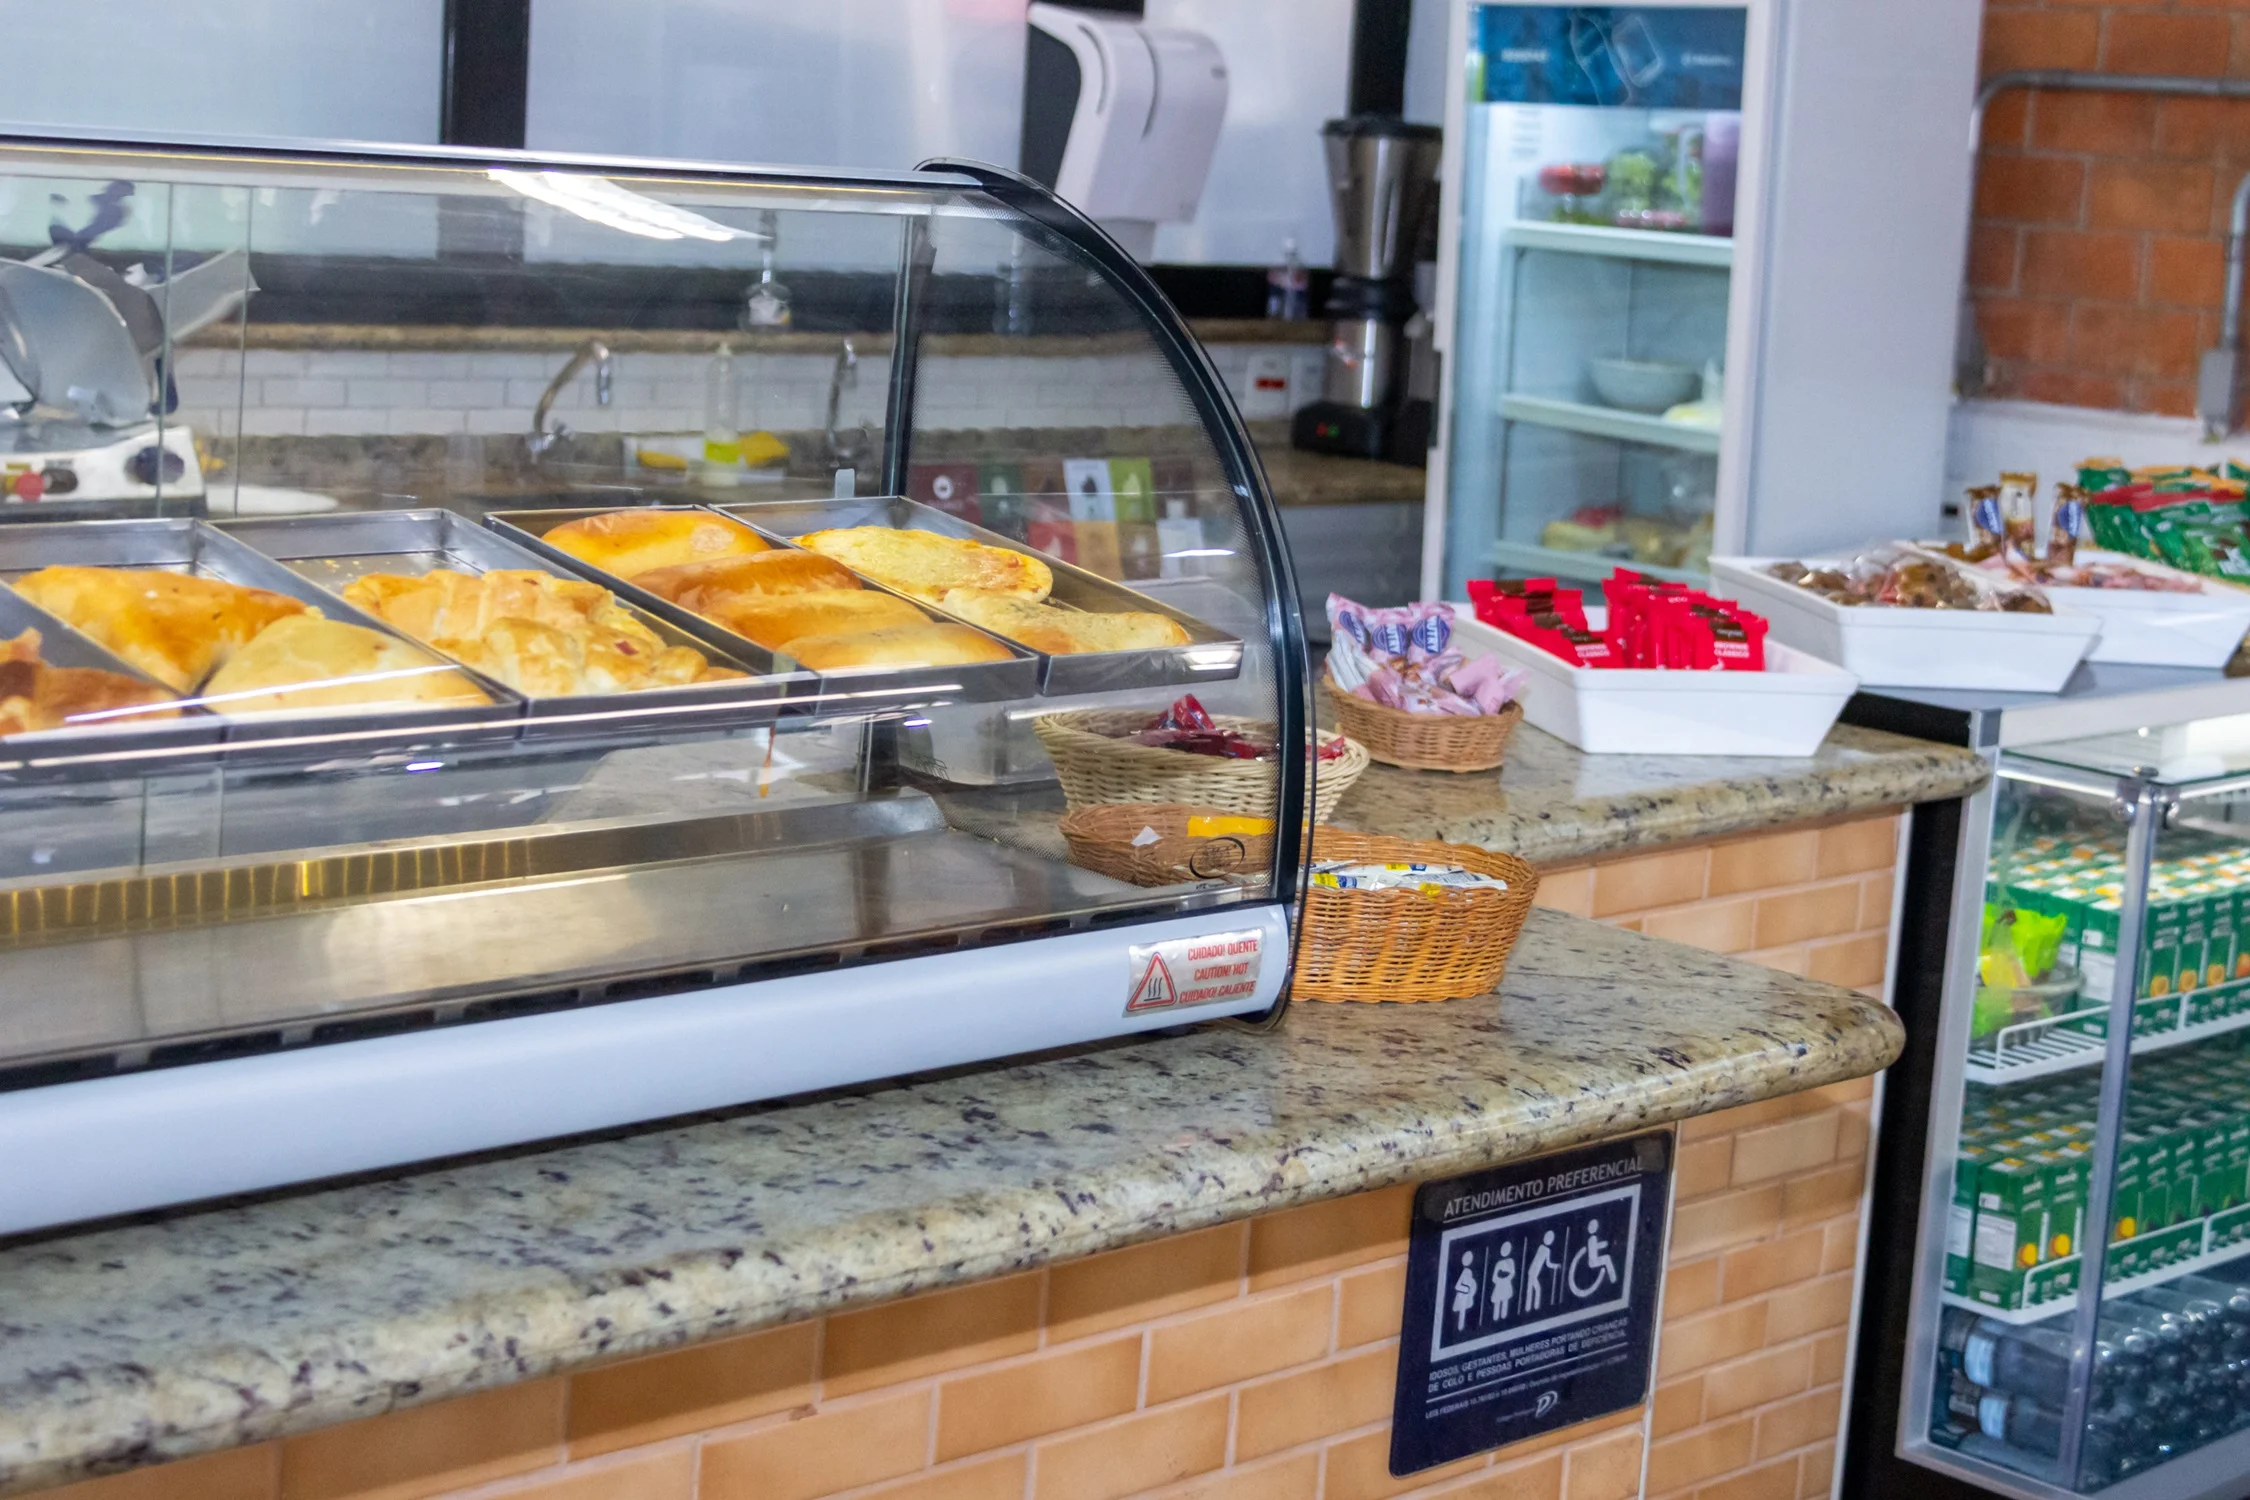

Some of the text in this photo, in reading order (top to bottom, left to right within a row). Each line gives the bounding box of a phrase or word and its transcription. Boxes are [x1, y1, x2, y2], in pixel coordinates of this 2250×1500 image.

[1188, 939, 1258, 961] CUIDADO! QUENTE
[1194, 962, 1249, 981] CAUTION! HOT
[1179, 980, 1256, 1004] CUIDADO! CALIENTE
[1443, 1156, 1643, 1219] ATENDIMENTO PREFERENCIAL
[1428, 1381, 1439, 1393] DE
[1442, 1374, 1465, 1389] COLO
[1467, 1371, 1474, 1382] E
[1476, 1360, 1512, 1379] PESSOAS
[1514, 1345, 1565, 1368] PORTADORAS
[1567, 1341, 1579, 1353] DE
